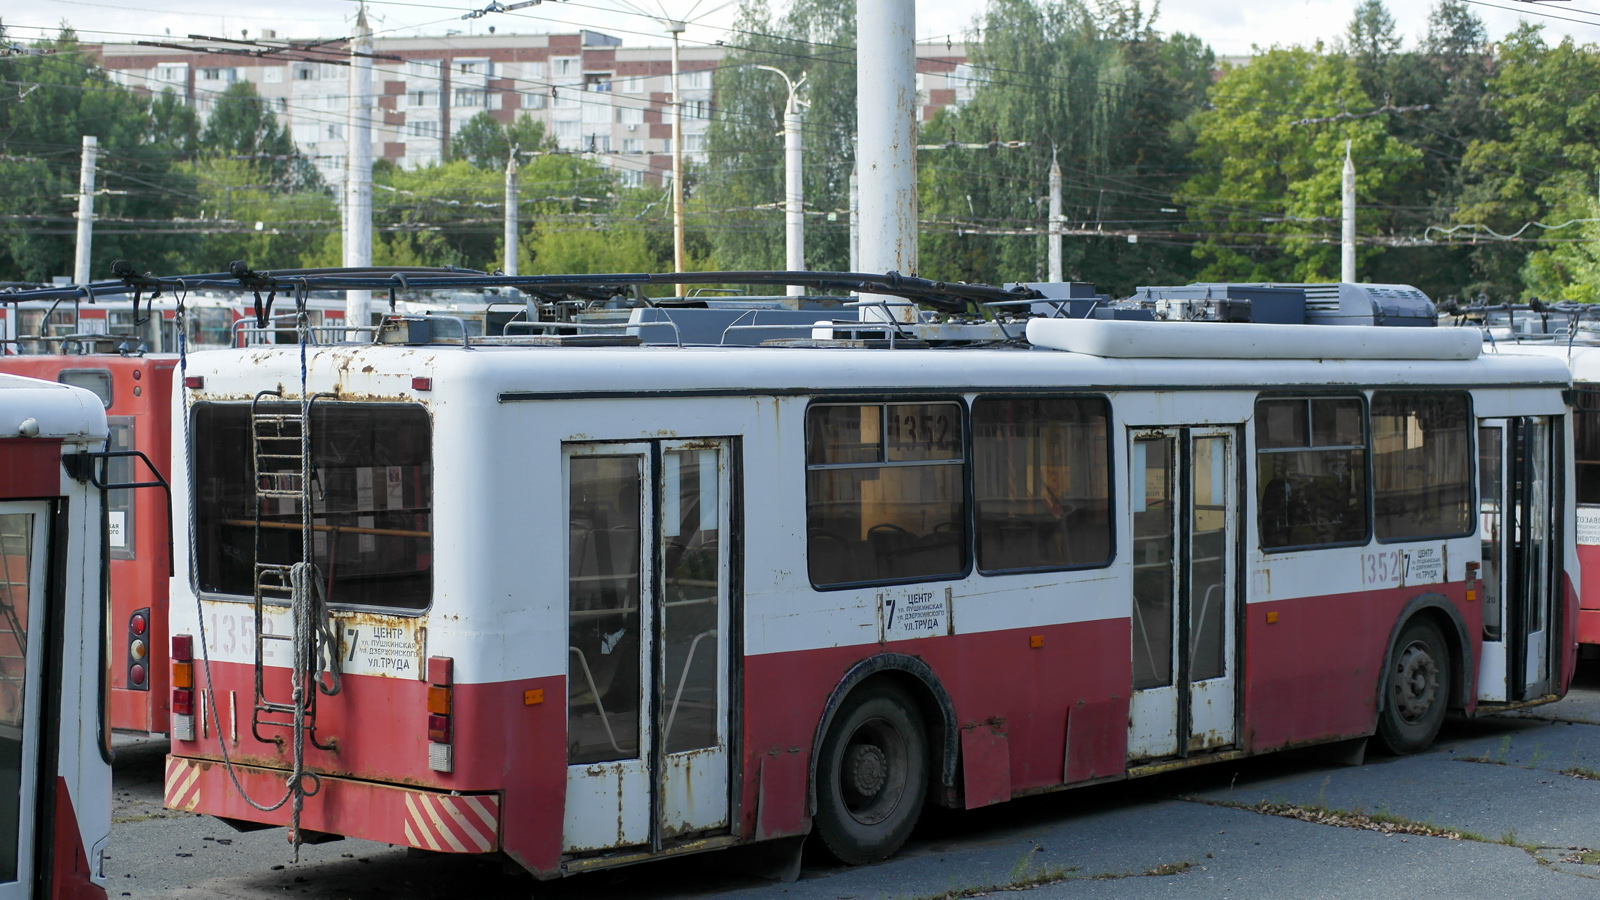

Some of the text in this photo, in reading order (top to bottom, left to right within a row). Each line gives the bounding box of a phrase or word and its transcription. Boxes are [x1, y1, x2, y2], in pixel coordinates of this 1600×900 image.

[894, 414, 949, 452] 1352
[1417, 548, 1434, 558] ЦЕНТР
[1360, 551, 1399, 584] 1352
[1404, 553, 1411, 578] 7
[907, 592, 933, 605] ЦЕНТР
[906, 603, 943, 612] ПУШКИНСКАЯ
[885, 599, 896, 630] 7
[904, 610, 945, 621] ДЗЕРЖИНСКОГО
[211, 613, 275, 658] 1352
[373, 626, 403, 639] ЦЕНТР
[347, 628, 359, 662] 7
[371, 639, 416, 650] ПУШКИНСКАЯ
[369, 647, 419, 658] ДЗЕРЖИНСКОГО
